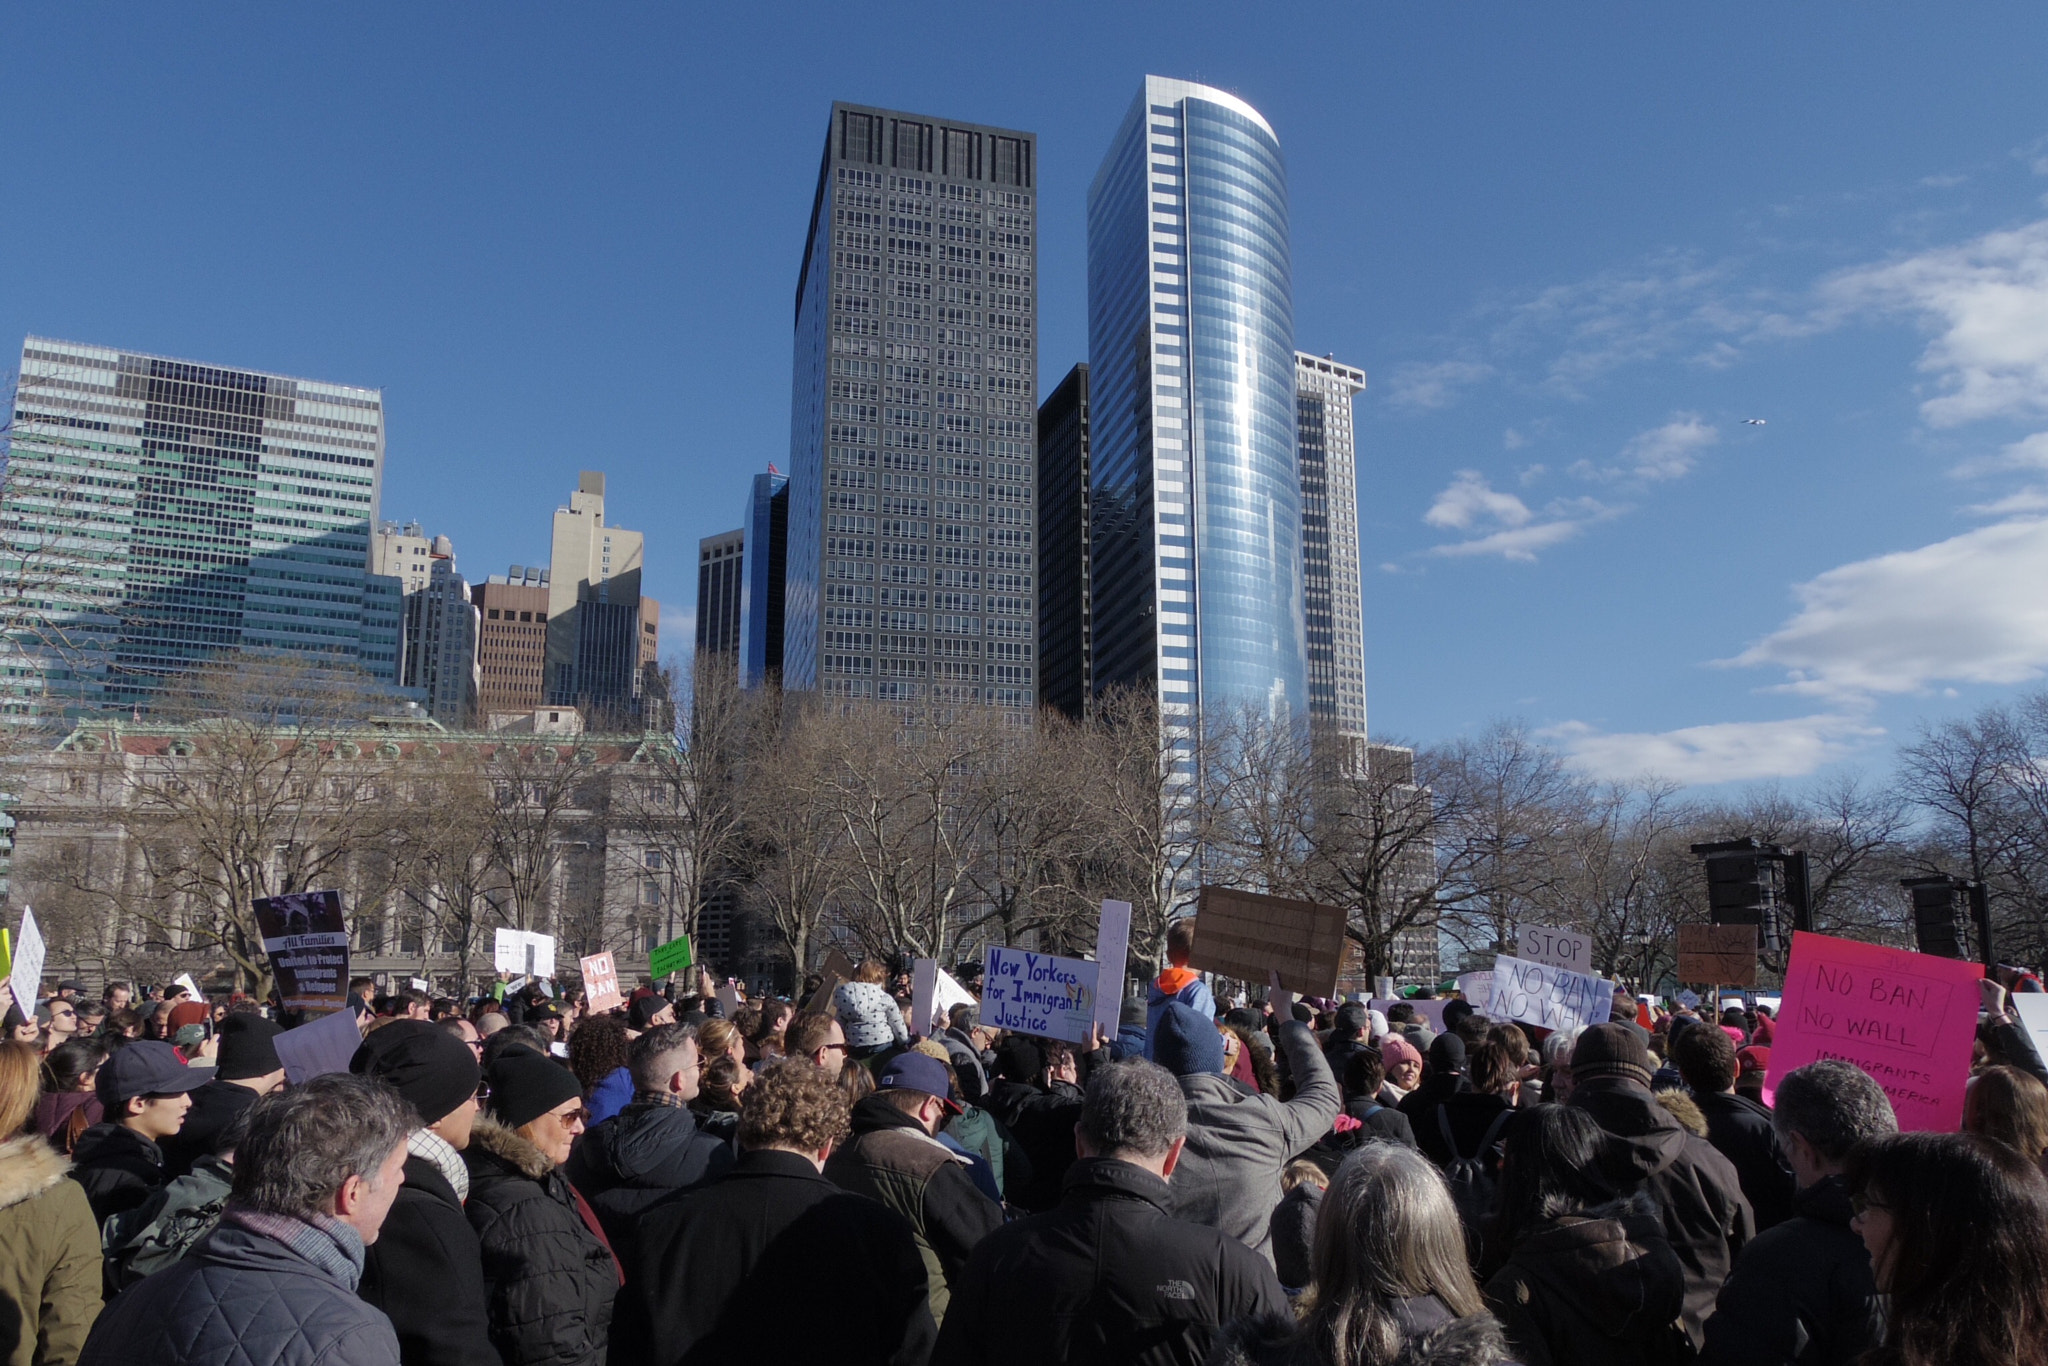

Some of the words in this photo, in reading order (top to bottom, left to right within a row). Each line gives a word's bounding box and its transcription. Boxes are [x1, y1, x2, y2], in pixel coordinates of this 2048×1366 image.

[283, 936, 297, 949] All
[301, 934, 335, 947] Families
[1527, 930, 1583, 961] STOP
[277, 955, 309, 968] United
[308, 955, 318, 965] to
[317, 953, 344, 965] Protect
[589, 956, 610, 977] NO
[990, 949, 1020, 977] New
[1025, 952, 1078, 984] Yorkers
[294, 968, 337, 979] Immigrants
[305, 981, 336, 993] Refugees
[587, 977, 616, 1000] BAN
[986, 977, 1005, 1000] for
[1011, 979, 1083, 1014] Immigrant
[1508, 963, 1544, 994] NO
[1550, 973, 1599, 1011] BAN
[1816, 964, 1853, 996] NO
[1870, 977, 1929, 1010] BAN
[1494, 990, 1529, 1017] NO
[994, 1002, 1047, 1031] Justice
[1805, 1005, 1834, 1029] NO
[1847, 1018, 1917, 1047] WALL
[1816, 1049, 1931, 1085] IMMIGRANTS
[1883, 1086, 1940, 1106] MERICA
[1156, 1284, 1183, 1293] NORTH
[1168, 1279, 1183, 1287] THE
[1164, 1291, 1183, 1299] FACE
